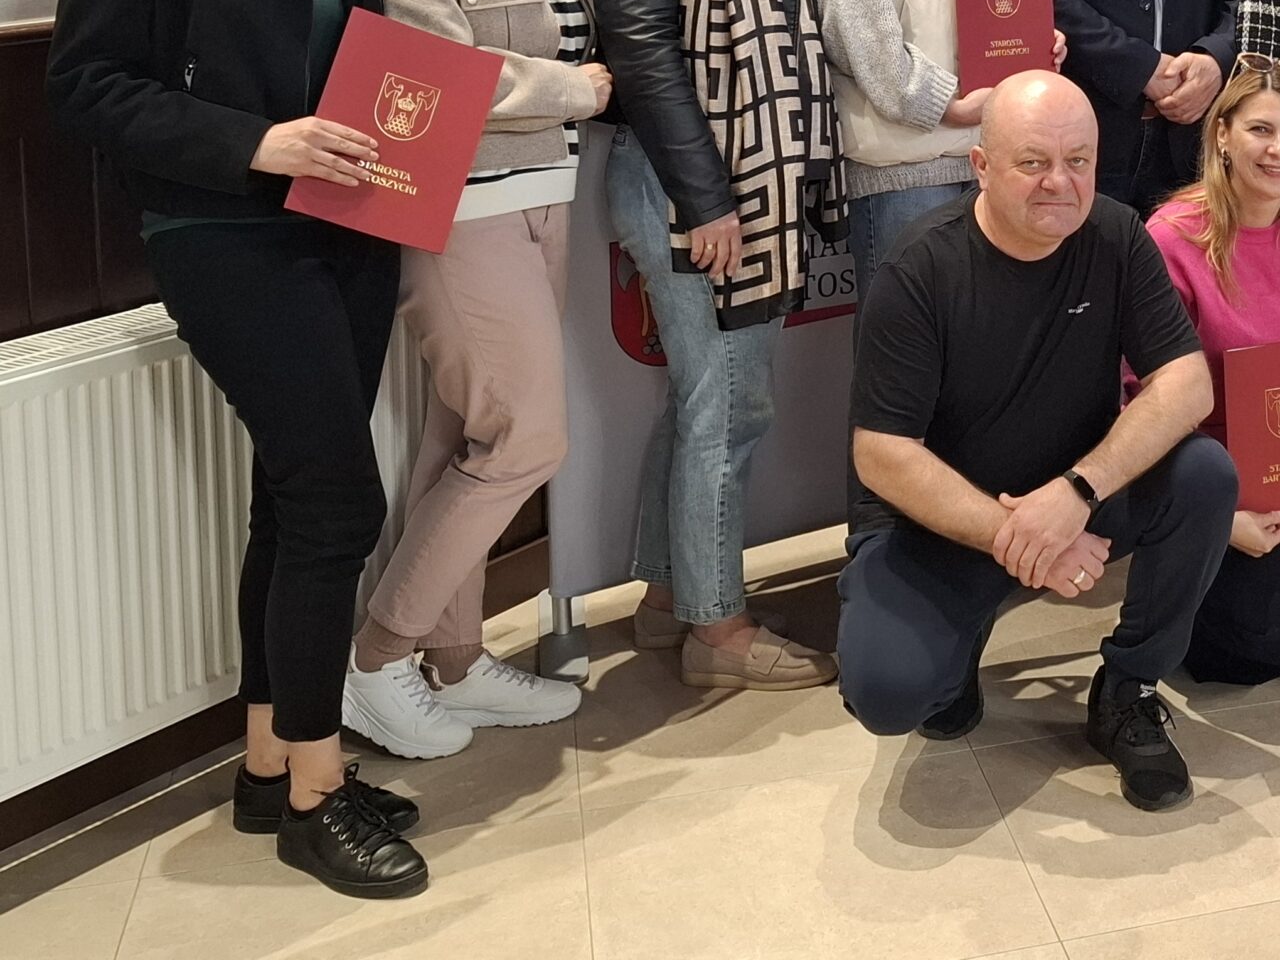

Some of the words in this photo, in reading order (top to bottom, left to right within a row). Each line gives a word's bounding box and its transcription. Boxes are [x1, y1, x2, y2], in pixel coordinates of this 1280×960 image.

[990, 38, 1024, 48] STAROSTA
[984, 47, 1030, 58] BARTOSZYCKI
[366, 174, 418, 196] OSZYCKI
